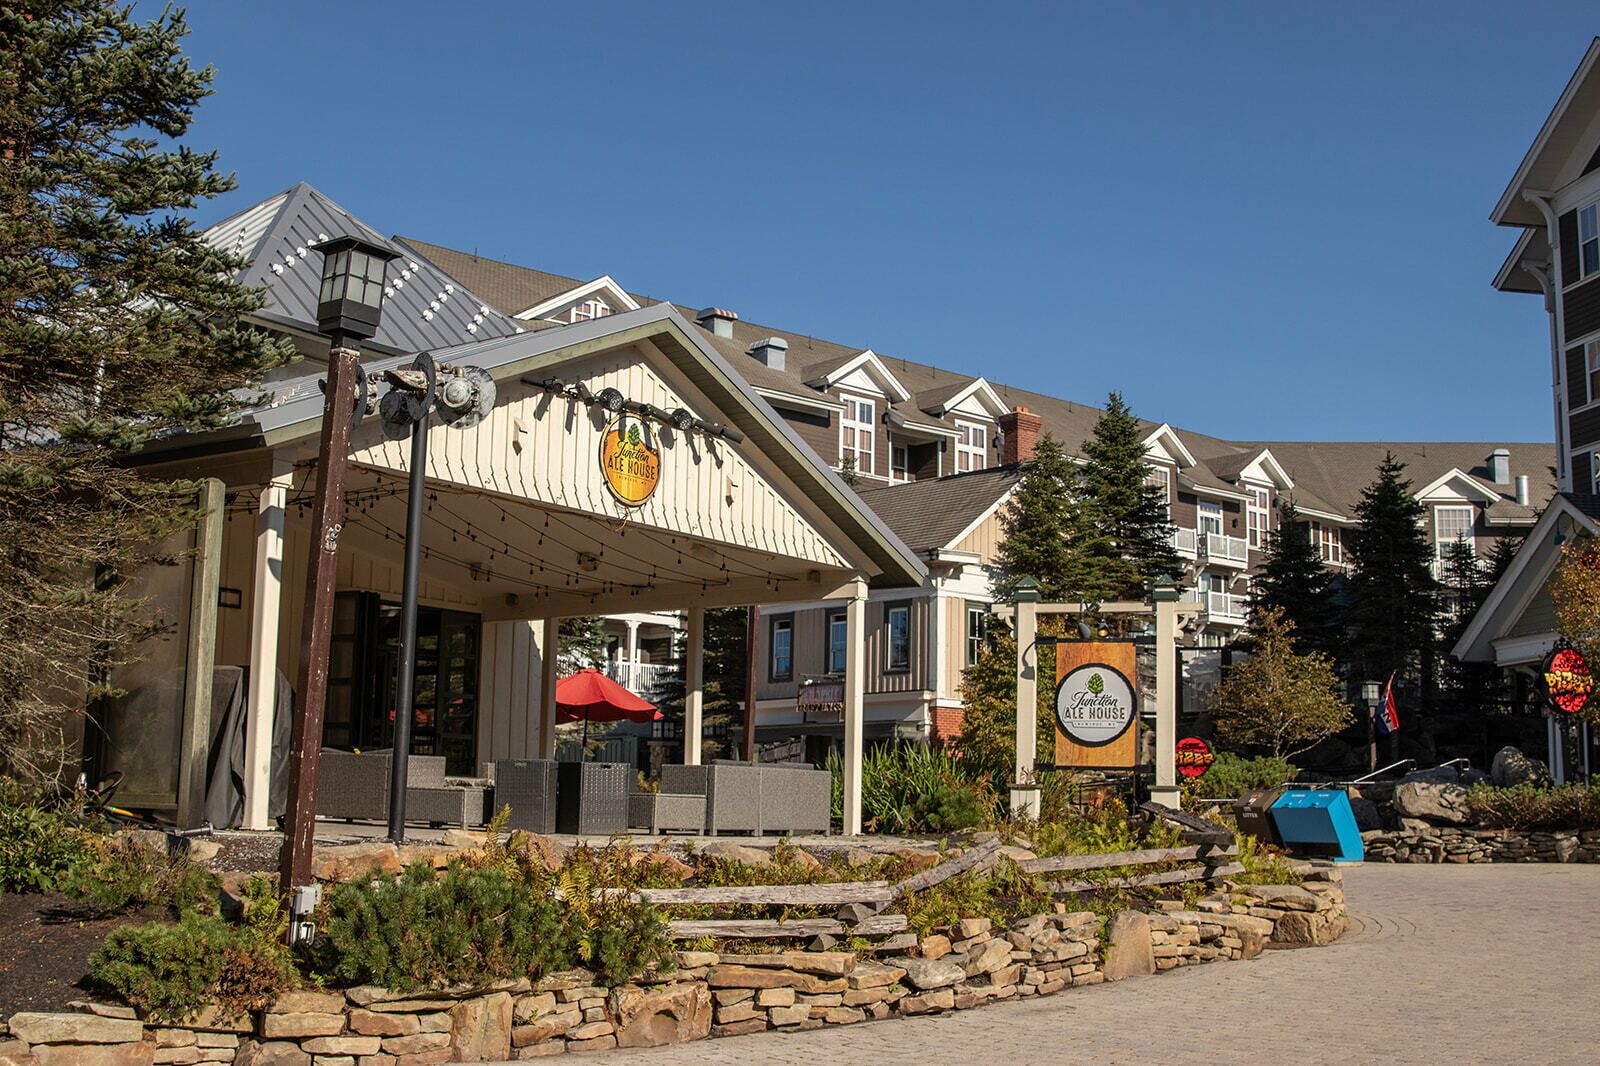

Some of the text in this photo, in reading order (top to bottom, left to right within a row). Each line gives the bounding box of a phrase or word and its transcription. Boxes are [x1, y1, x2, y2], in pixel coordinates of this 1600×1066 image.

[614, 441, 650, 464] Junction
[607, 455, 655, 480] ALE HOUSE
[1070, 691, 1118, 710] Junction
[1064, 707, 1125, 720] ALE HOUSE
